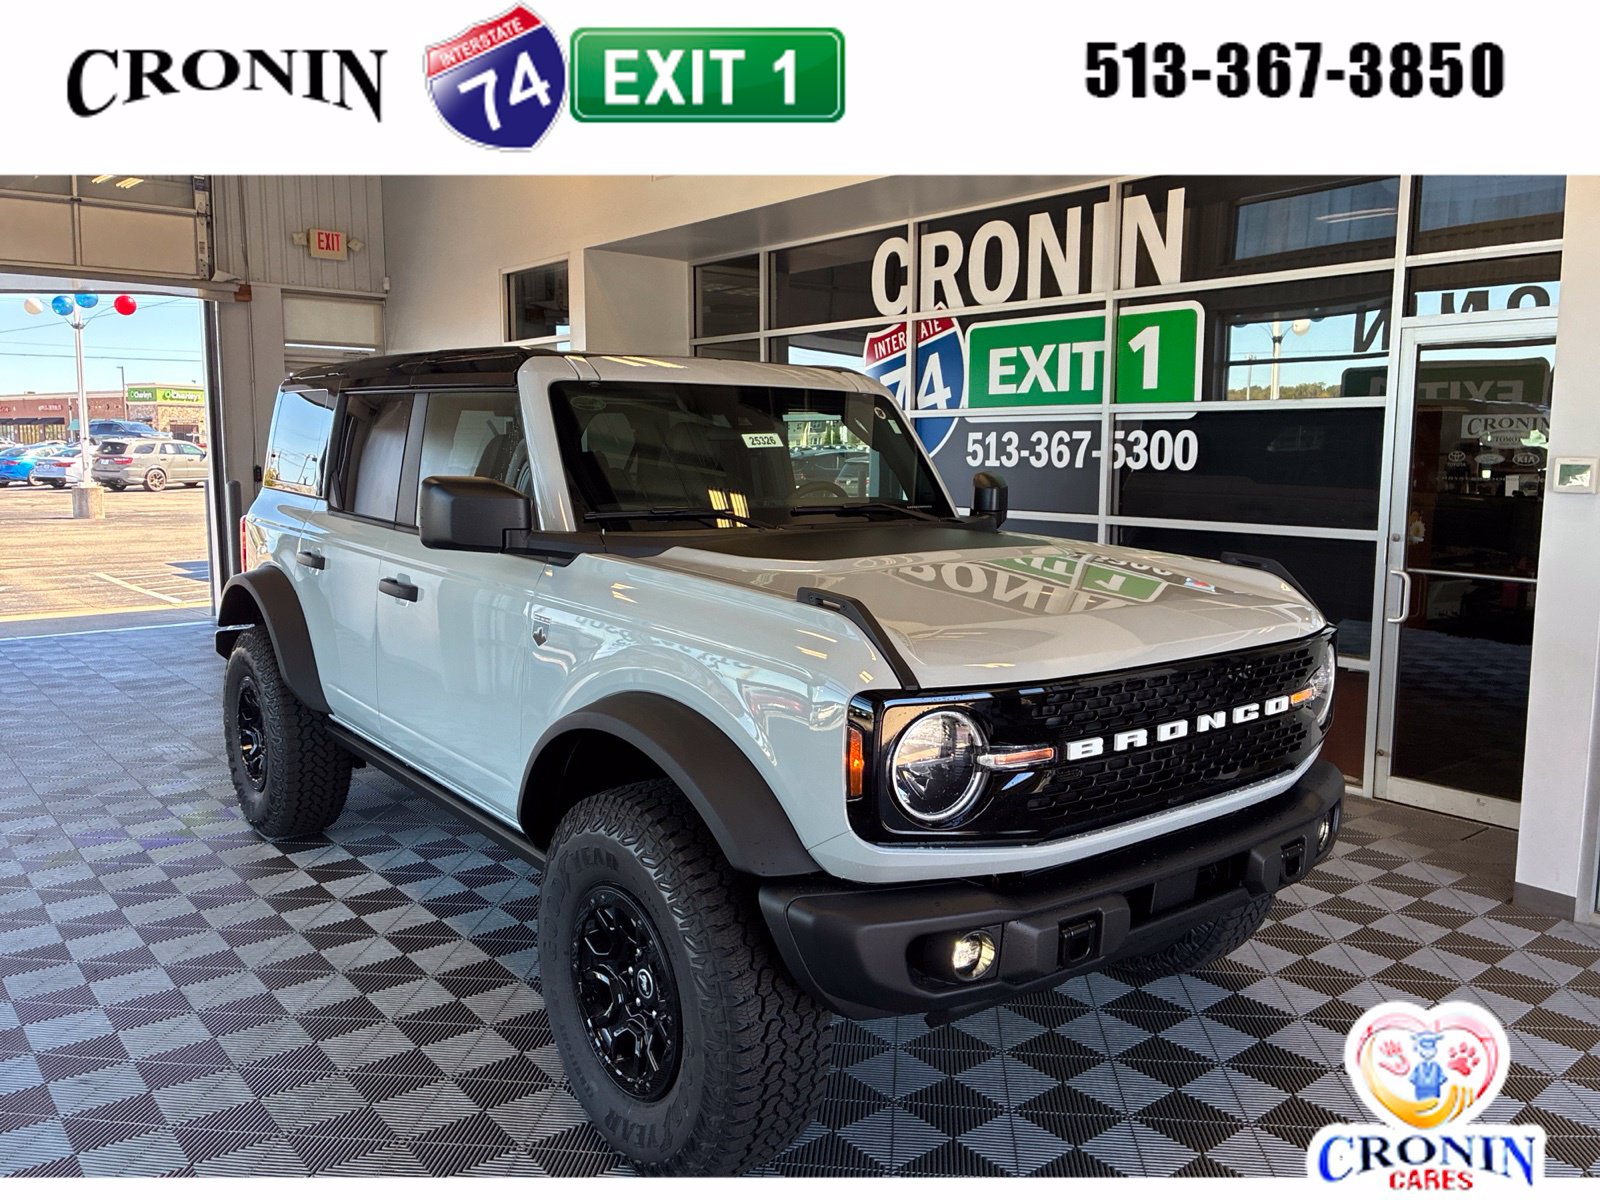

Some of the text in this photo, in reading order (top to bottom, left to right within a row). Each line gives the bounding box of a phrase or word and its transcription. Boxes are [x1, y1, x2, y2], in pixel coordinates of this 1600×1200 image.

[317, 231, 341, 252] EXIT
[871, 187, 1186, 316] CRONIN
[873, 319, 942, 359] INTERATE
[988, 325, 1160, 394] EXIT 1
[749, 433, 777, 446] 25326
[1516, 455, 1535, 465] KIA
[1066, 694, 1289, 761] BRONCO
